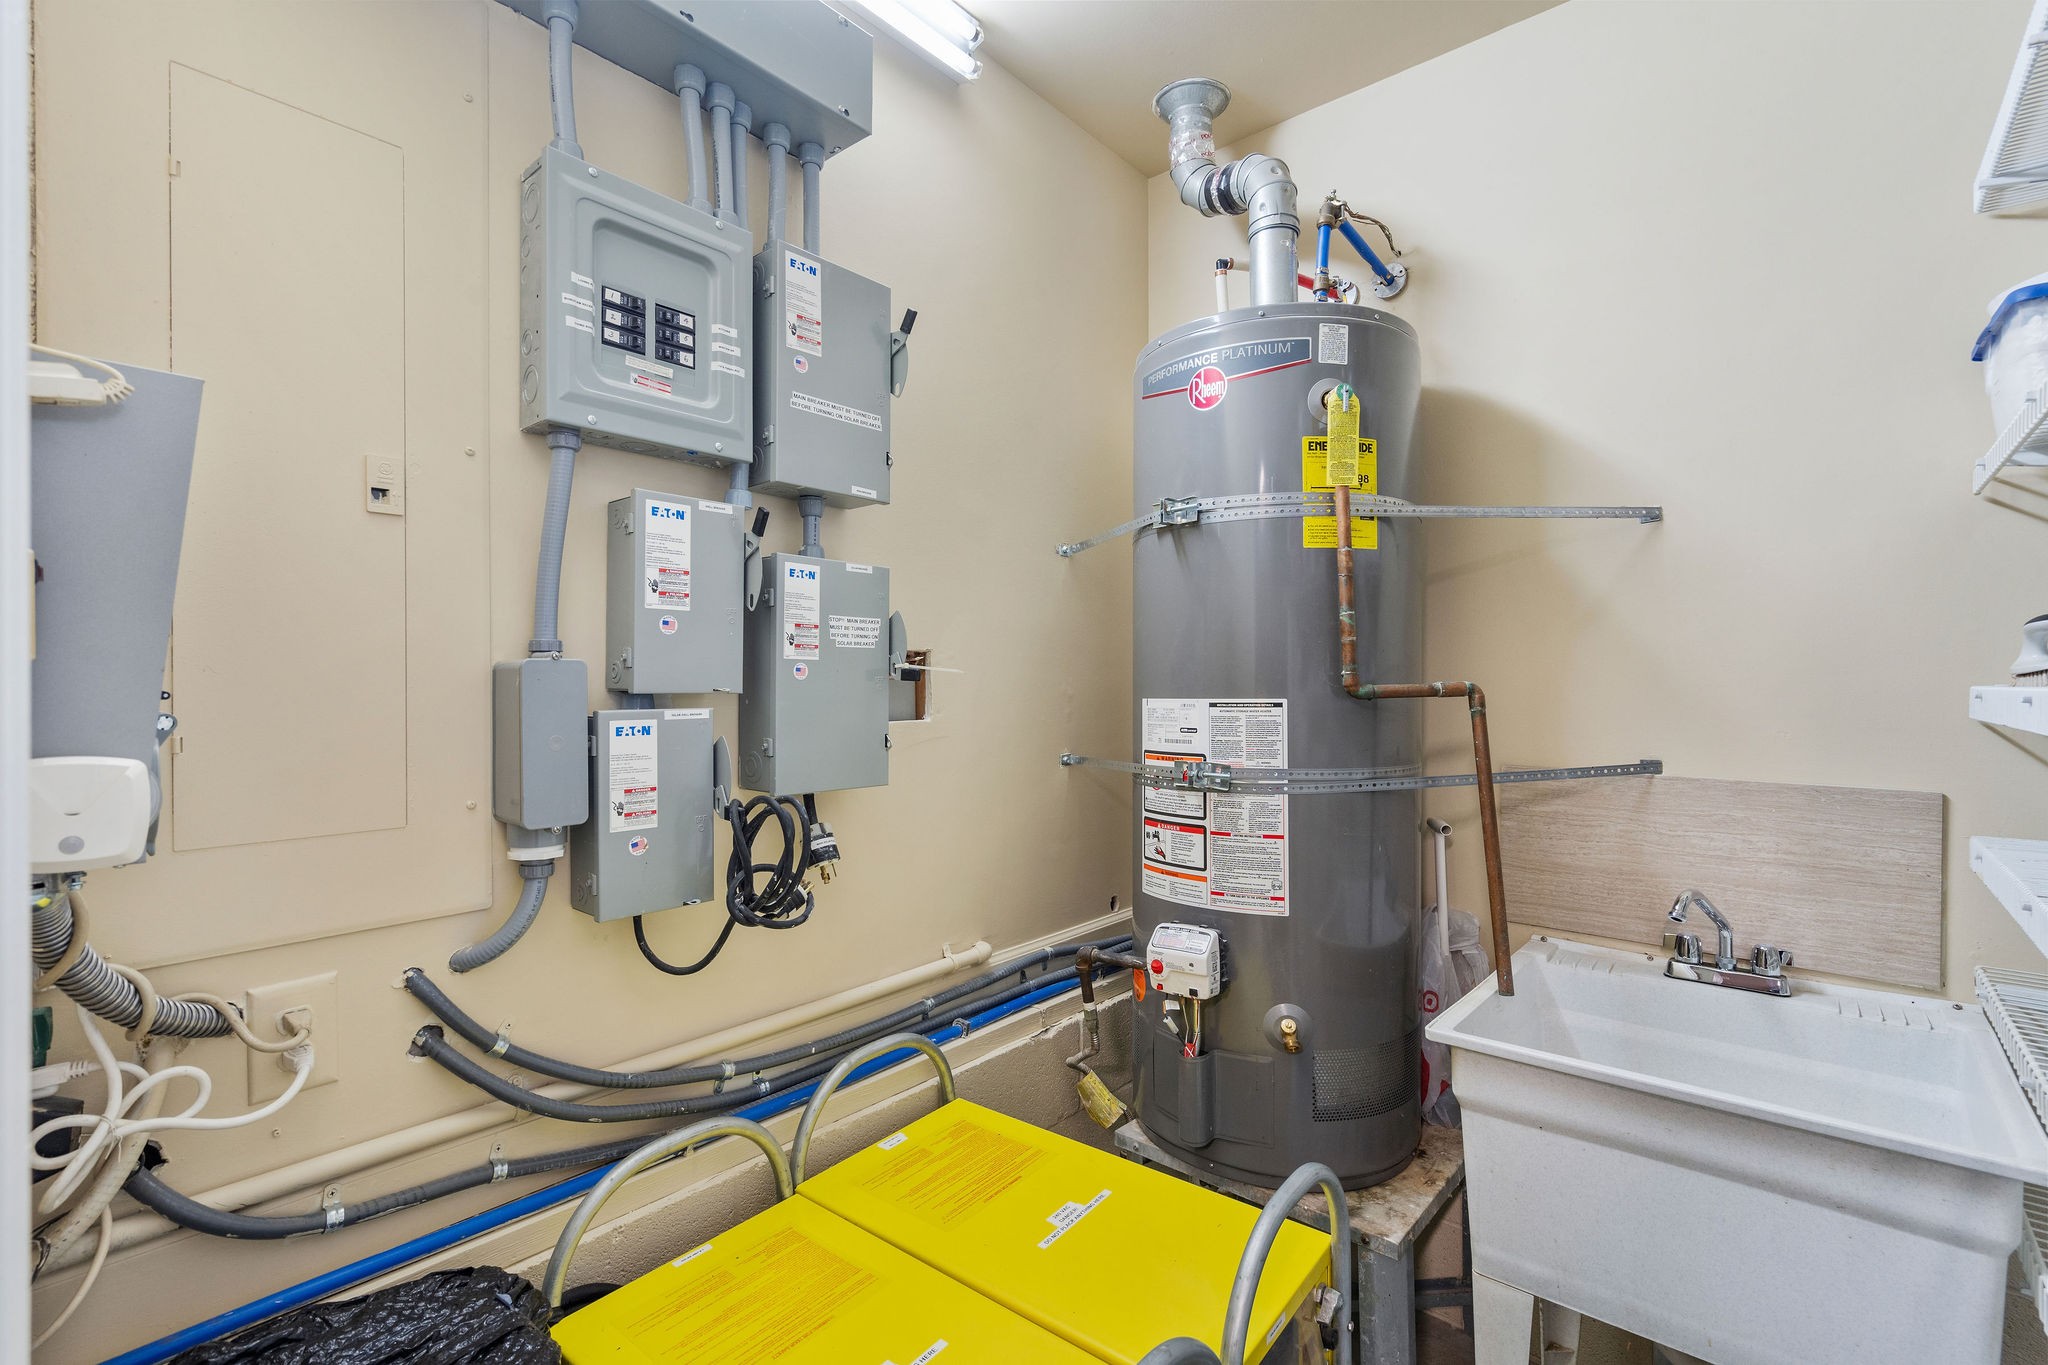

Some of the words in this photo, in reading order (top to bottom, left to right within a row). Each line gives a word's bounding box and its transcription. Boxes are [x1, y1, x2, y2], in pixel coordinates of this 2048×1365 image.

[790, 258, 816, 276] EATON
[1148, 352, 1218, 386] PERFORMANCE
[1222, 342, 1291, 360] PLATINUM
[1192, 368, 1224, 404] Rheem
[791, 401, 811, 411] BEFORE
[813, 407, 835, 417] TURNING
[844, 415, 860, 424] SOLAR
[860, 420, 881, 429] BREAKER
[793, 393, 806, 401] MAIN
[806, 397, 830, 408] BREAKER
[831, 404, 844, 412] MUST
[853, 410, 871, 420] TURNED
[1308, 441, 1327, 451] ENE
[1359, 443, 1373, 453] IDE
[1358, 474, 1369, 483] 98
[651, 506, 685, 520] EATON
[789, 568, 816, 580] EATON
[615, 725, 651, 736] EATON
[1060, 1219, 1074, 1231] PLACE
[1074, 1203, 1095, 1220] ANYTHING
[919, 1347, 937, 1363] HERE
